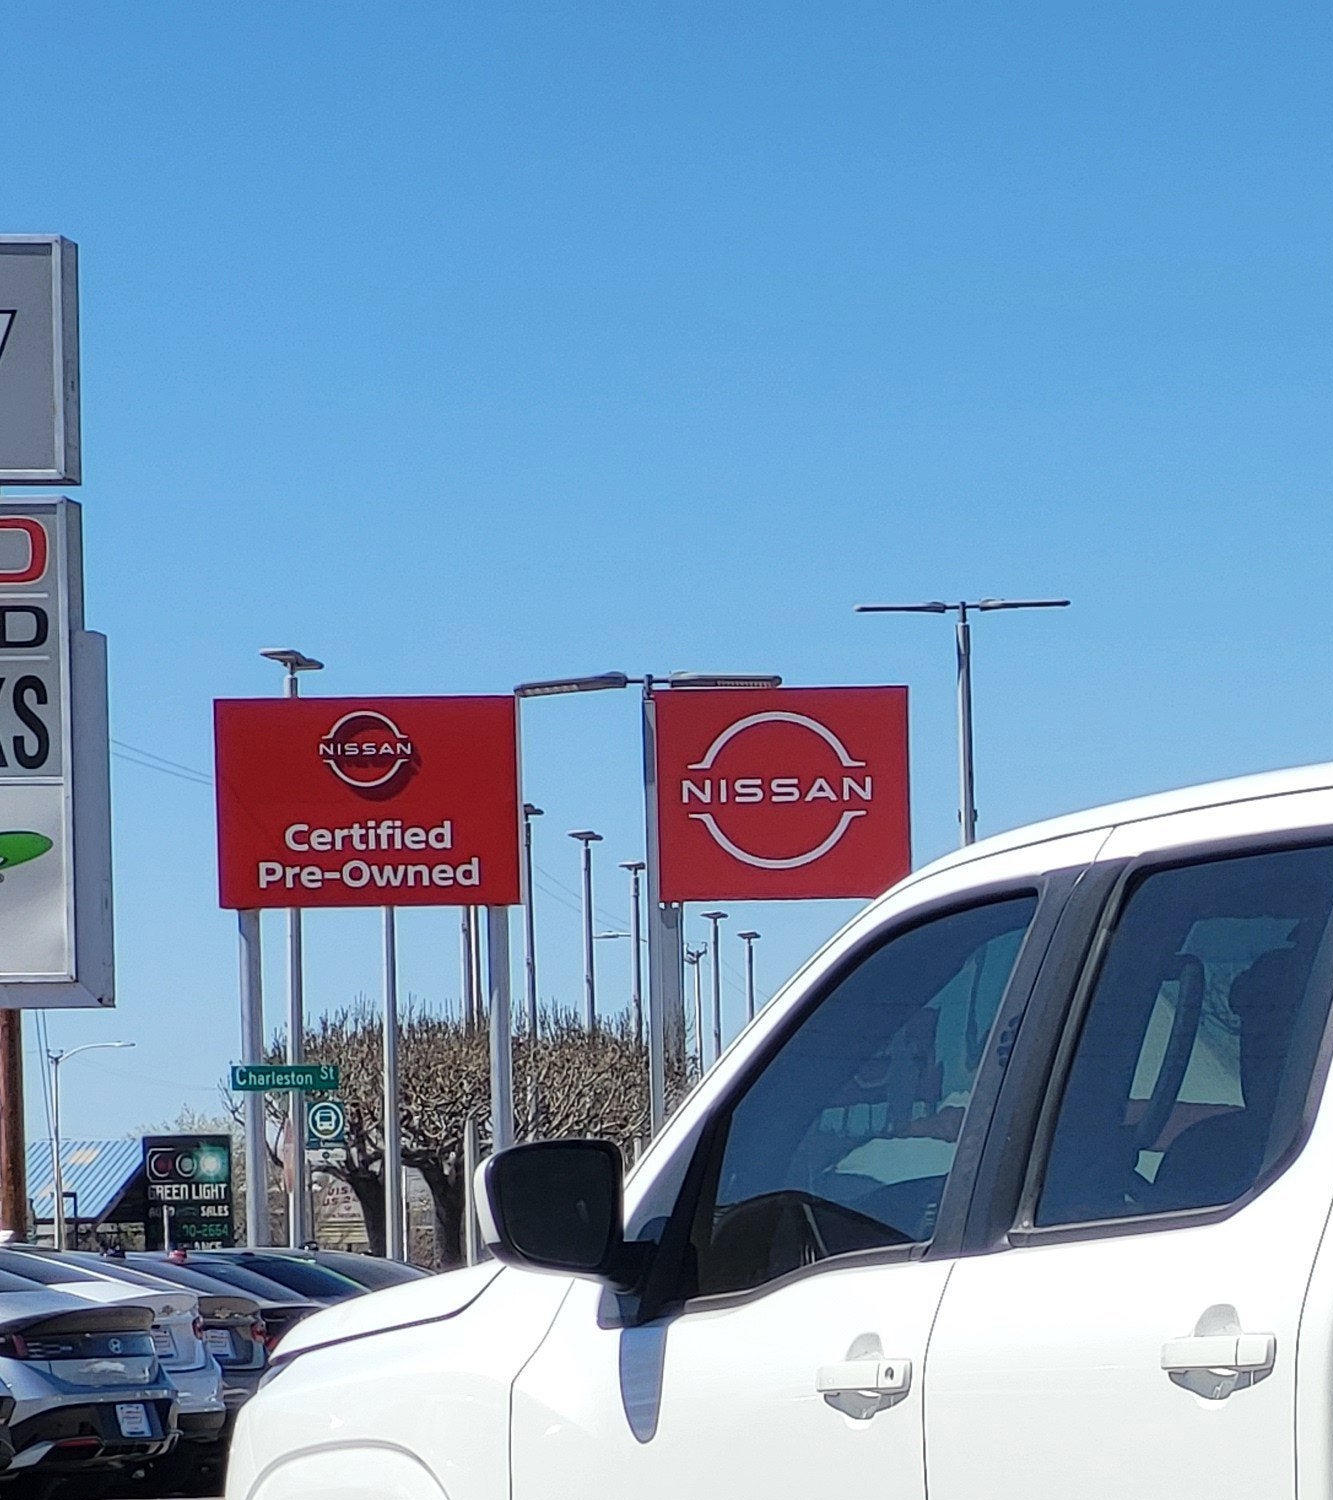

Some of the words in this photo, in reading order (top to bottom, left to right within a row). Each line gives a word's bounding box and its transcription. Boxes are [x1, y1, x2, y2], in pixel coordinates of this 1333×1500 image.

[319, 742, 411, 756] NISSAN
[681, 776, 873, 804] NISSAN
[284, 821, 452, 852] Certified
[258, 857, 480, 889] Pre-Owned
[235, 1066, 314, 1086] Charleston
[320, 1065, 335, 1081] St
[148, 1183, 189, 1200] GREEN
[192, 1183, 227, 1200] LIGHT
[200, 1205, 229, 1217] SALES
